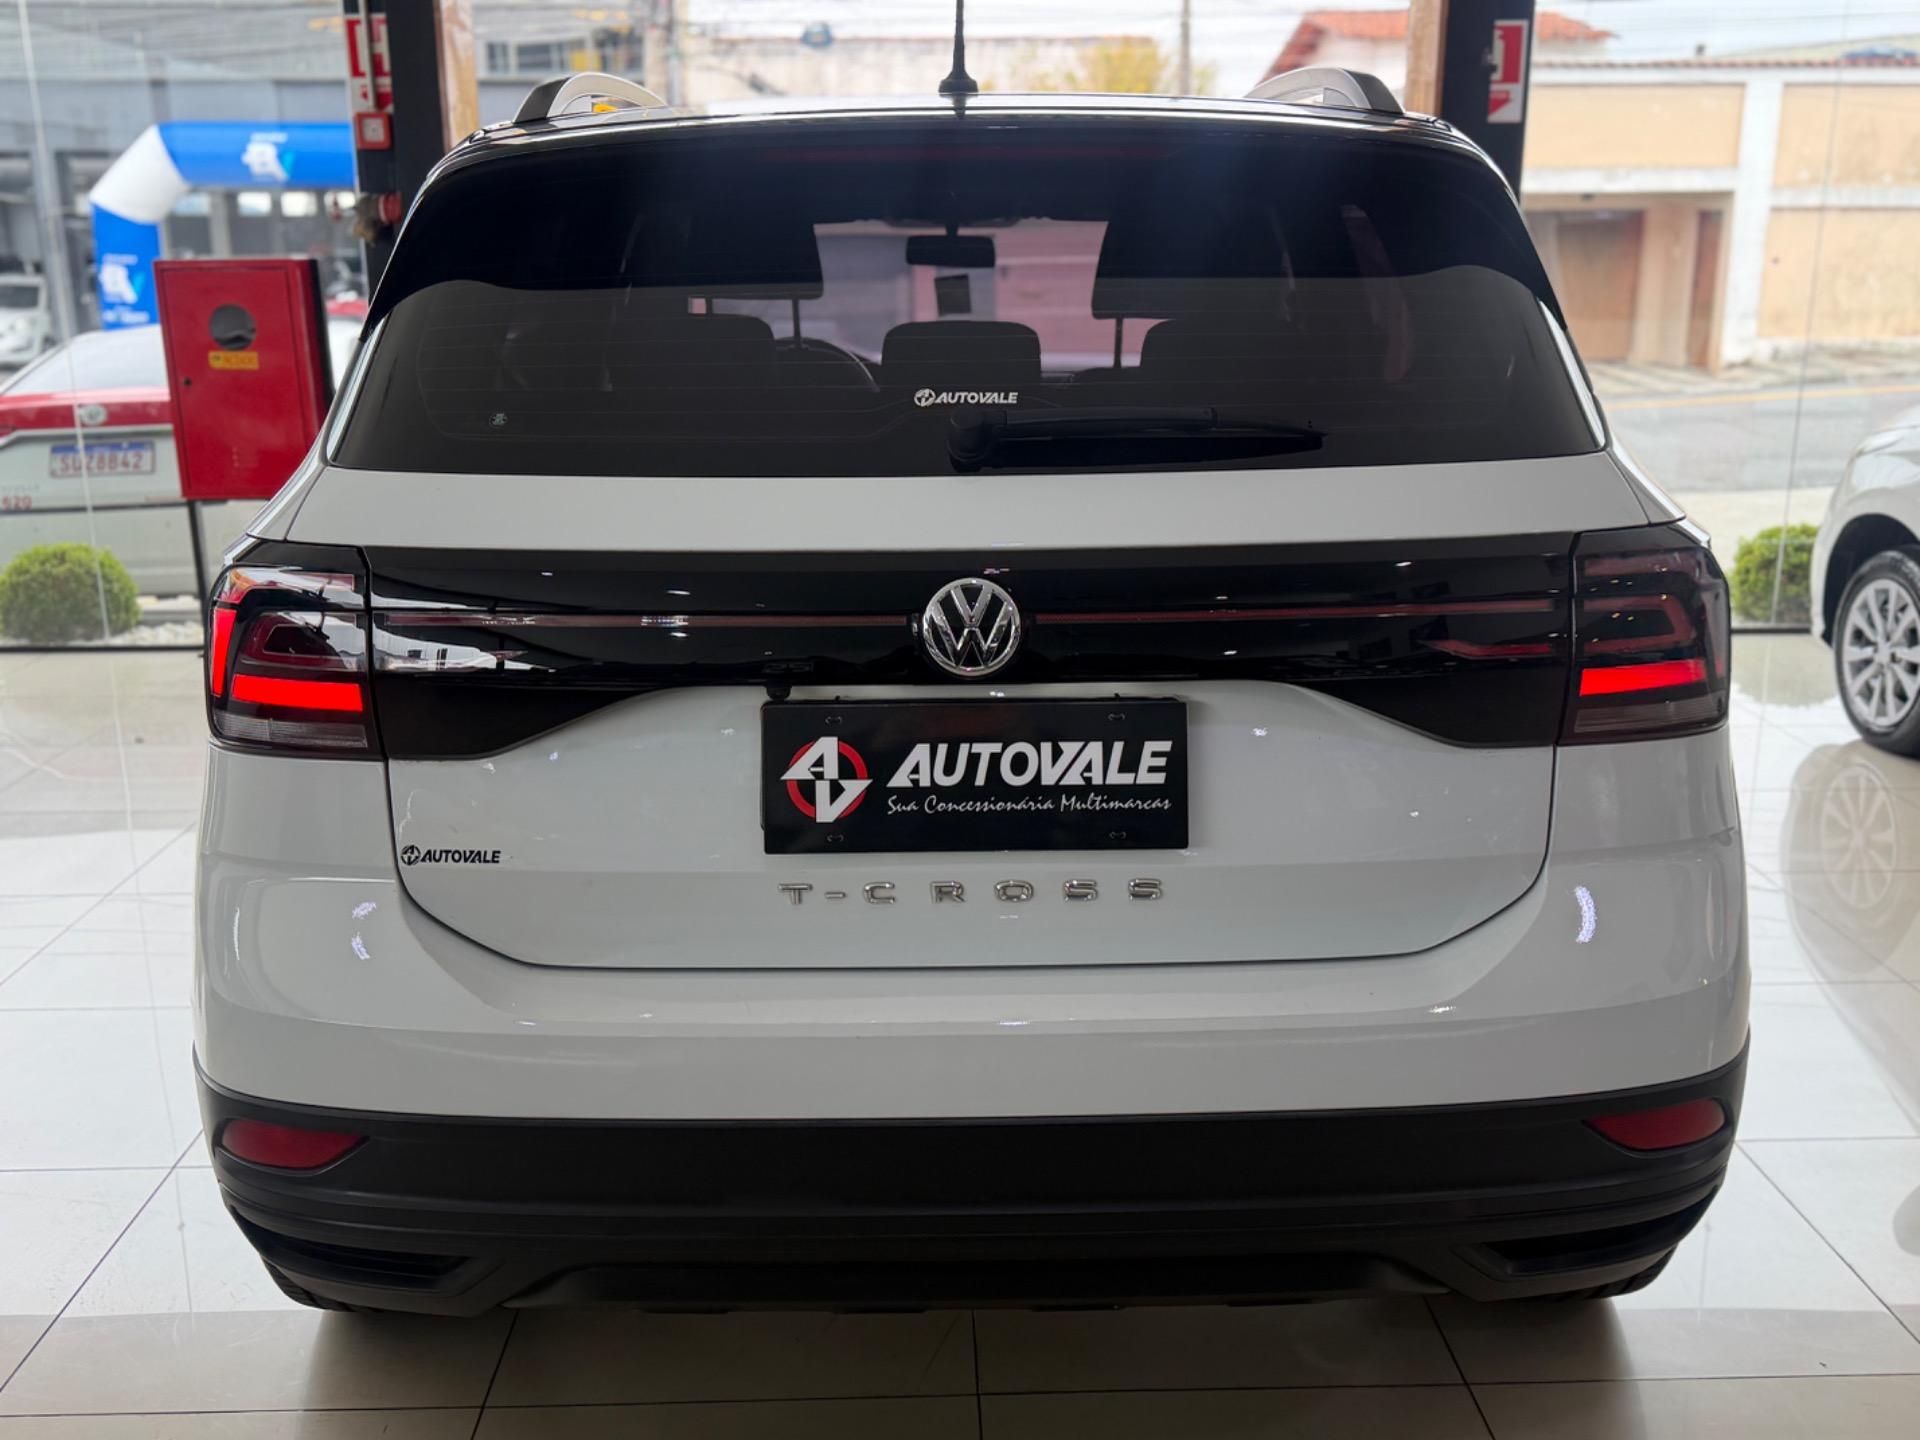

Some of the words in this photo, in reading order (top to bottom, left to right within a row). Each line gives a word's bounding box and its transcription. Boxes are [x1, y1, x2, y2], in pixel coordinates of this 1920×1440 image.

[935, 392, 1018, 404] AUTOVALE
[886, 741, 1173, 788] AUTOVALE
[887, 794, 919, 815] Sua
[924, 794, 1056, 814] Concessionária
[1060, 792, 1172, 812] Multimarcas
[420, 849, 501, 864] AUTOVALE
[778, 878, 1163, 905] T-CROSS
